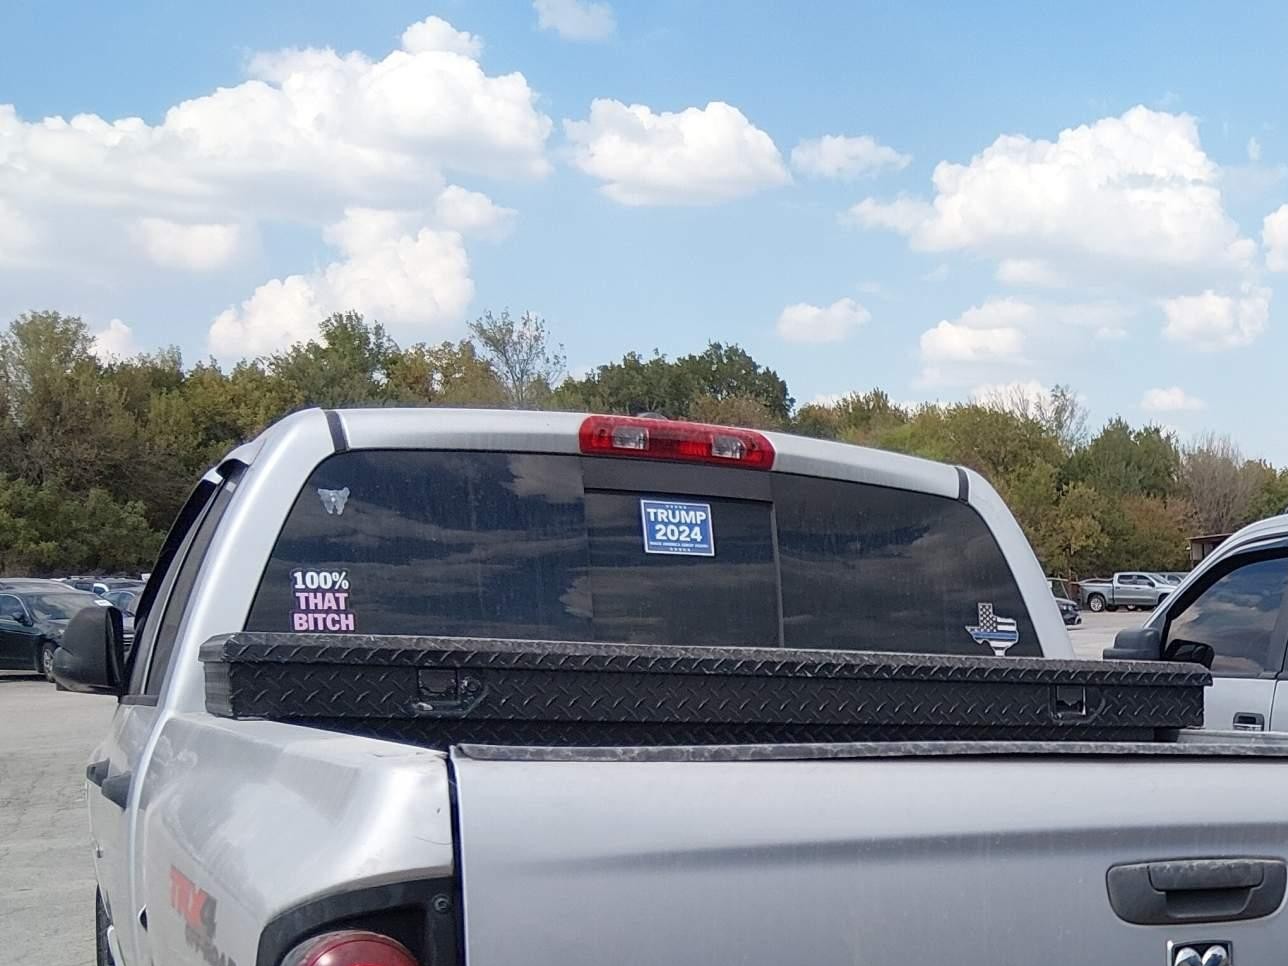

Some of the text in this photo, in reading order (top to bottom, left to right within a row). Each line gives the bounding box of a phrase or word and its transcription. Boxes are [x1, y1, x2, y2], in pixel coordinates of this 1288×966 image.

[646, 508, 707, 525] TRUMP
[655, 524, 703, 542] 2024
[293, 571, 350, 590] 100%
[295, 592, 349, 610] THAT
[293, 613, 355, 631] BITCH
